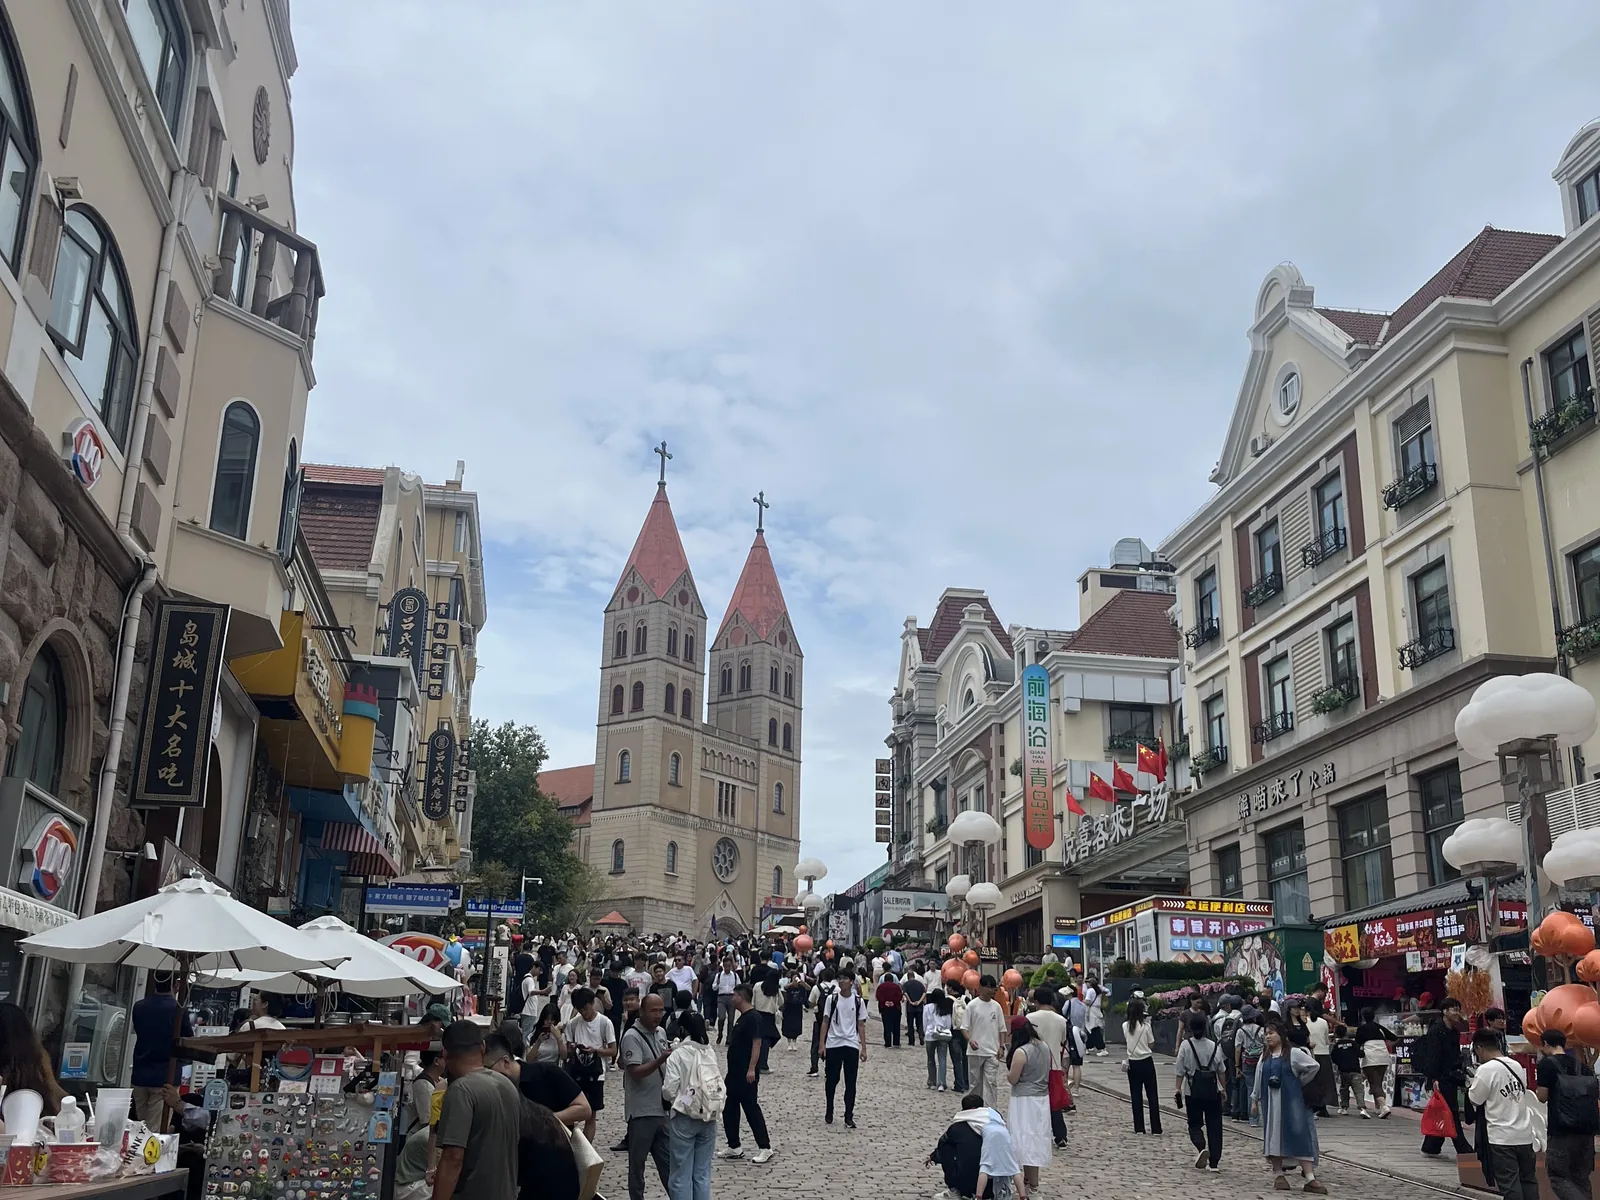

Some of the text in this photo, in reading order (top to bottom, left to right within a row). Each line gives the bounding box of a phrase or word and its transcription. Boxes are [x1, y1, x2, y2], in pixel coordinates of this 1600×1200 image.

[157, 619, 199, 787] 岛城十大名吃
[1027, 676, 1047, 747] 前海沿
[1030, 767, 1049, 833] 青岛菜
[1185, 900, 1246, 913] 幸运便利店
[1436, 915, 1457, 927] 老北京
[1437, 925, 1465, 938] 冰糖葫芦
